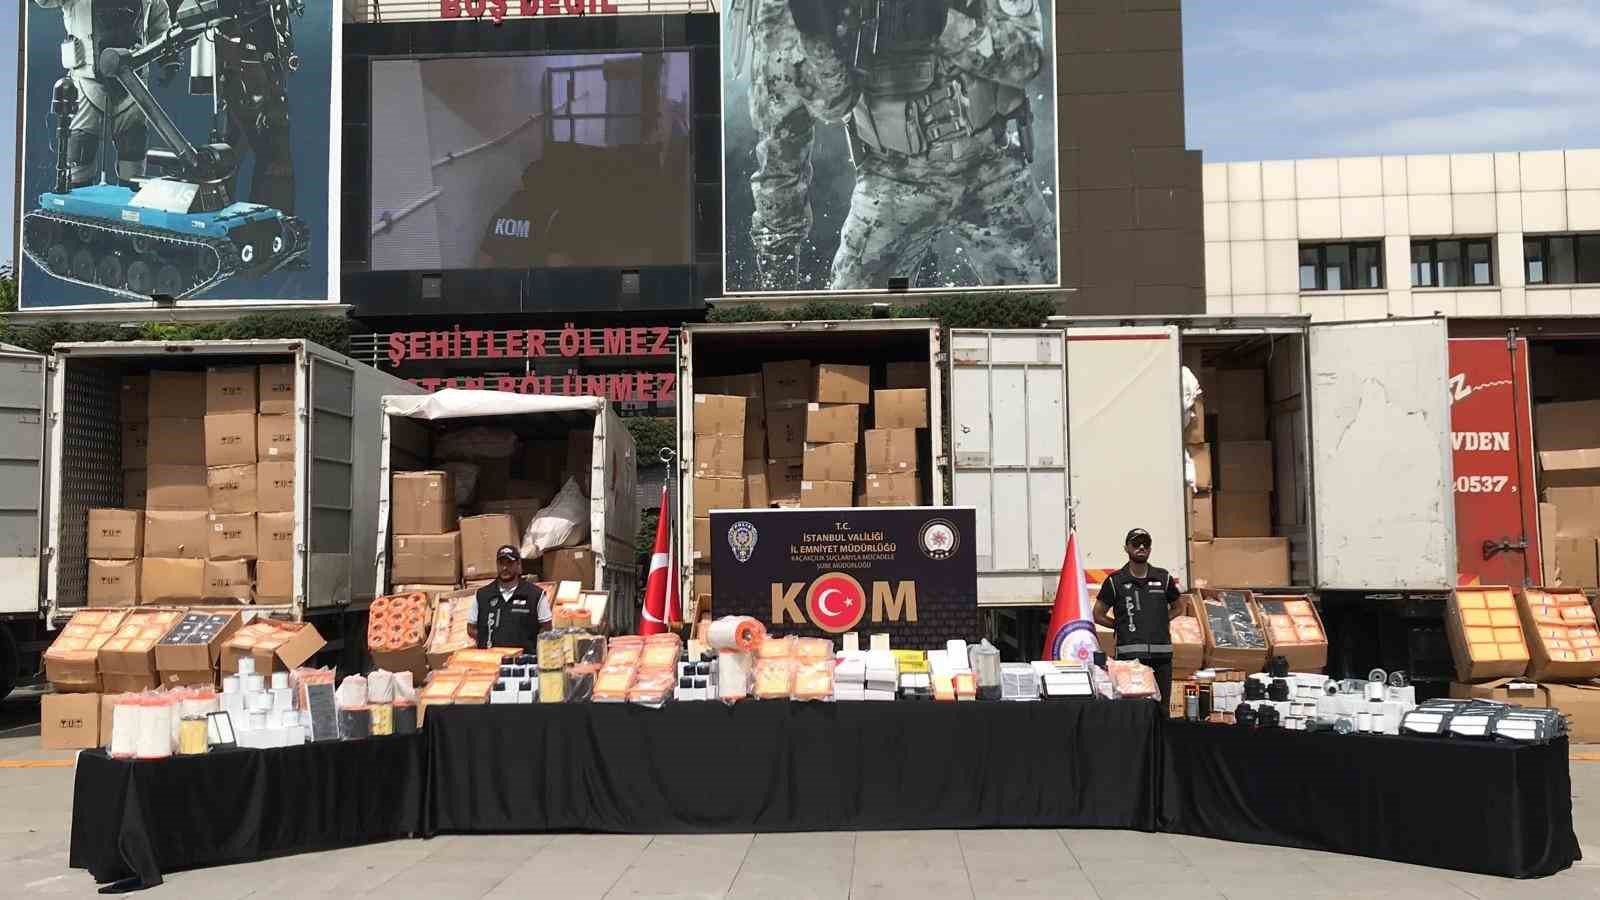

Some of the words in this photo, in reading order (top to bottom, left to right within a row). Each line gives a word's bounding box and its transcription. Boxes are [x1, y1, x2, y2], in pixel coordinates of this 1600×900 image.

[495, 218, 529, 238] KOM
[388, 324, 546, 367] ŞEHİTLER
[560, 322, 670, 357] ÖLMEZ
[835, 522, 851, 530] T.C.
[803, 532, 846, 542] İSTANBUL
[848, 531, 883, 542] VALİLİĞİ
[790, 544, 799, 554] İL
[800, 543, 838, 553] EMNİYET
[840, 542, 897, 553] MÜDÜRLÜĞÜ
